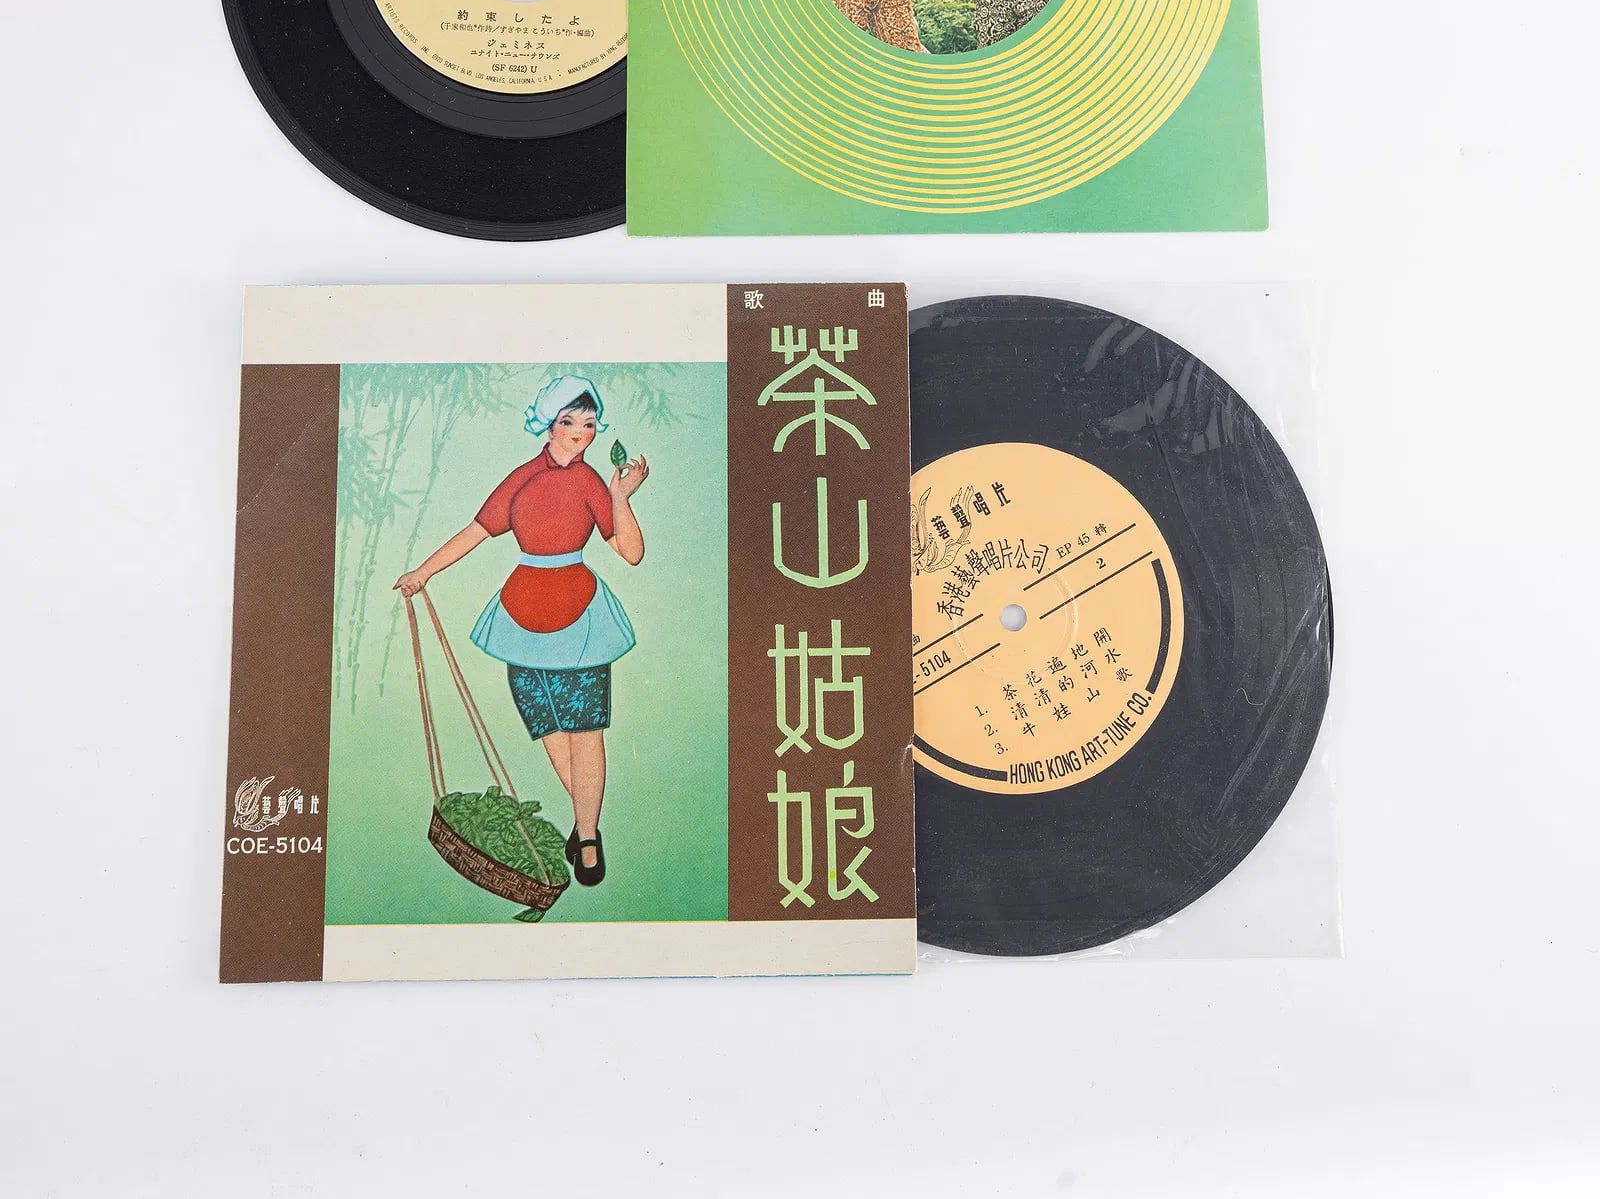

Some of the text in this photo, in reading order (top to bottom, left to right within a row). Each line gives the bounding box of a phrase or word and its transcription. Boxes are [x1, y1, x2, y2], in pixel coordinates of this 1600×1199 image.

[385, 2, 400, 24] ARTISTS
[457, 10, 580, 26] 約束したよ
[487, 39, 545, 50] ジェミネス
[492, 64, 538, 74] (SF 6242) U
[568, 57, 599, 74] MANUFACTURED
[931, 482, 1011, 540] 藝聲唱片
[1056, 542, 1073, 559] EP
[1077, 533, 1090, 547] 45
[1095, 558, 1107, 569] 2
[937, 538, 1049, 620] 香港藝聲唱片公司
[757, 324, 880, 909] 茶山姑娘
[975, 627, 1112, 718] 1. 茶花遍地開
[984, 648, 1121, 737] 2. 清清的河水
[994, 742, 1008, 755] 3.
[1010, 692, 1152, 784] HONG KONG ART-TUNE CO.
[226, 836, 323, 854] COE-5104
